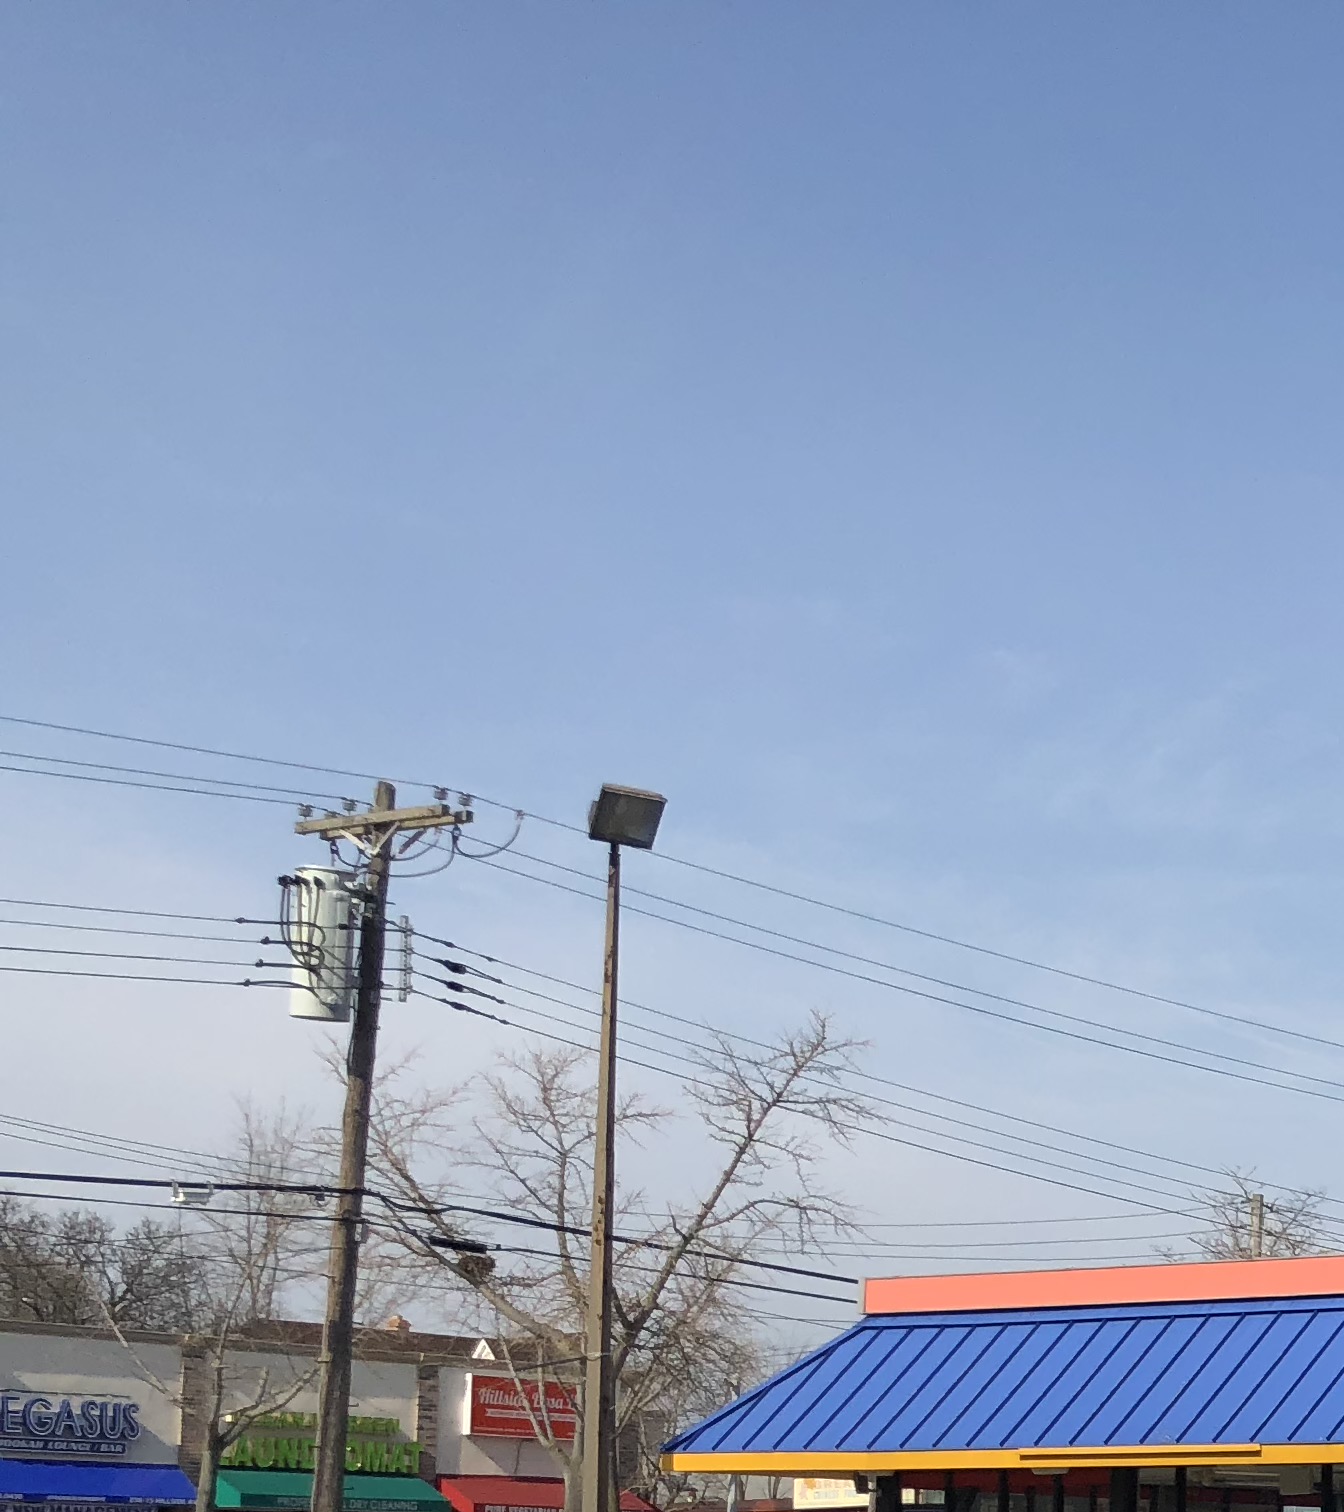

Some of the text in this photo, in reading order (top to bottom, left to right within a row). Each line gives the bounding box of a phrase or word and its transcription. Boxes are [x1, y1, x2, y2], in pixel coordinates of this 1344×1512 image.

[532, 1391, 563, 1410] Dsa
[0, 1396, 140, 1440] EGASUS
[101, 1443, 123, 1453] BAR
[219, 1432, 424, 1474] LAUNDOMAT
